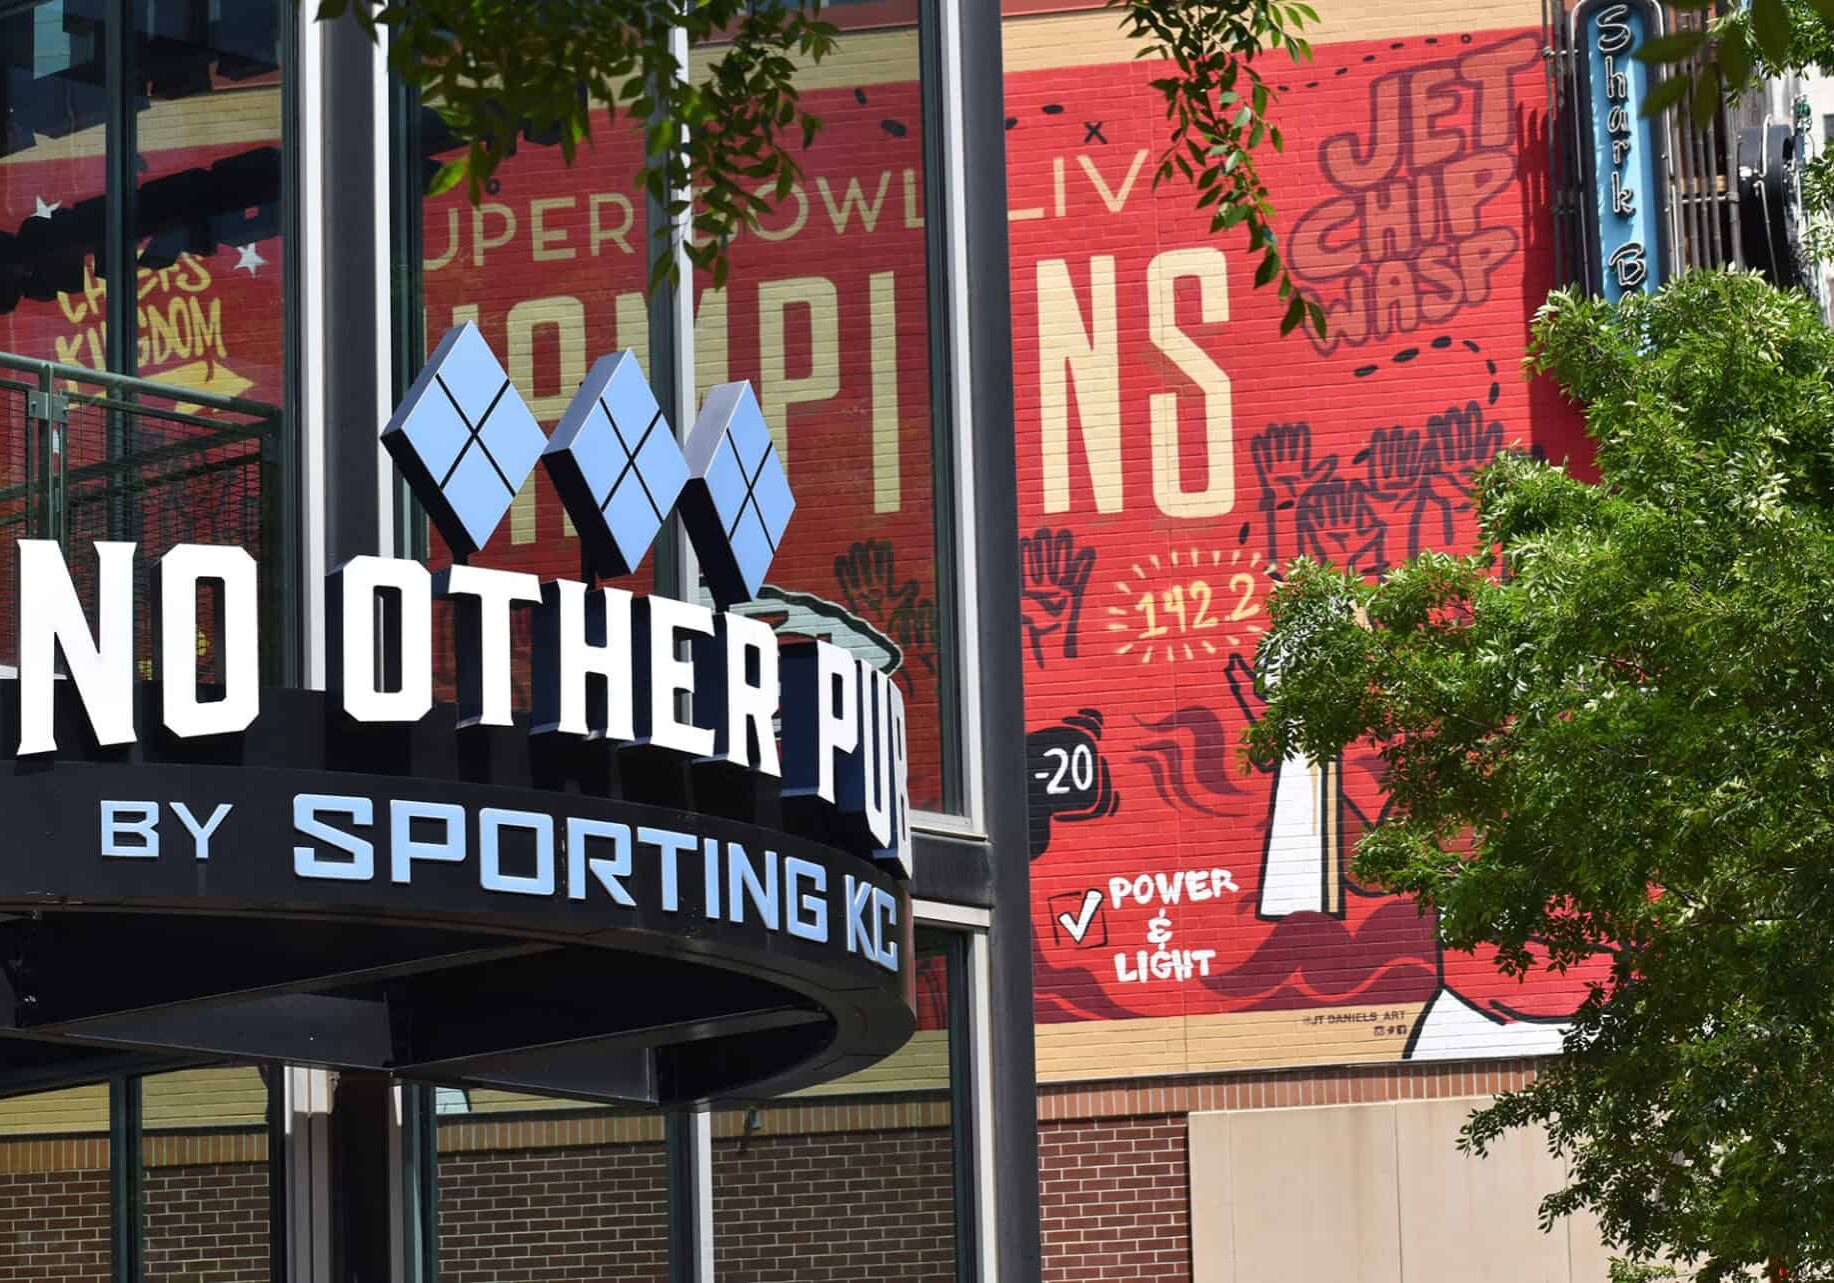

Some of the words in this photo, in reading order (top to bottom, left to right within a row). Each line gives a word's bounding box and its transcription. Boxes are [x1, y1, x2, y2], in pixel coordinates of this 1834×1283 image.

[1318, 31, 1543, 193] JET
[1595, 4, 1633, 214] Shark
[1287, 148, 1519, 283] CHIP
[1300, 226, 1519, 357] WASP
[1608, 242, 1646, 303] B
[1135, 573, 1261, 639] 142.2
[17, 539, 259, 755] NO
[343, 555, 782, 778] OTHER
[817, 640, 913, 880] PUB
[1034, 743, 1094, 794] -20
[101, 799, 233, 858] BY
[293, 793, 828, 943] SPORTING
[844, 874, 898, 972] KC
[1109, 868, 1239, 908] POWER
[1147, 909, 1172, 949] &
[1114, 947, 1216, 984] LIGHT
